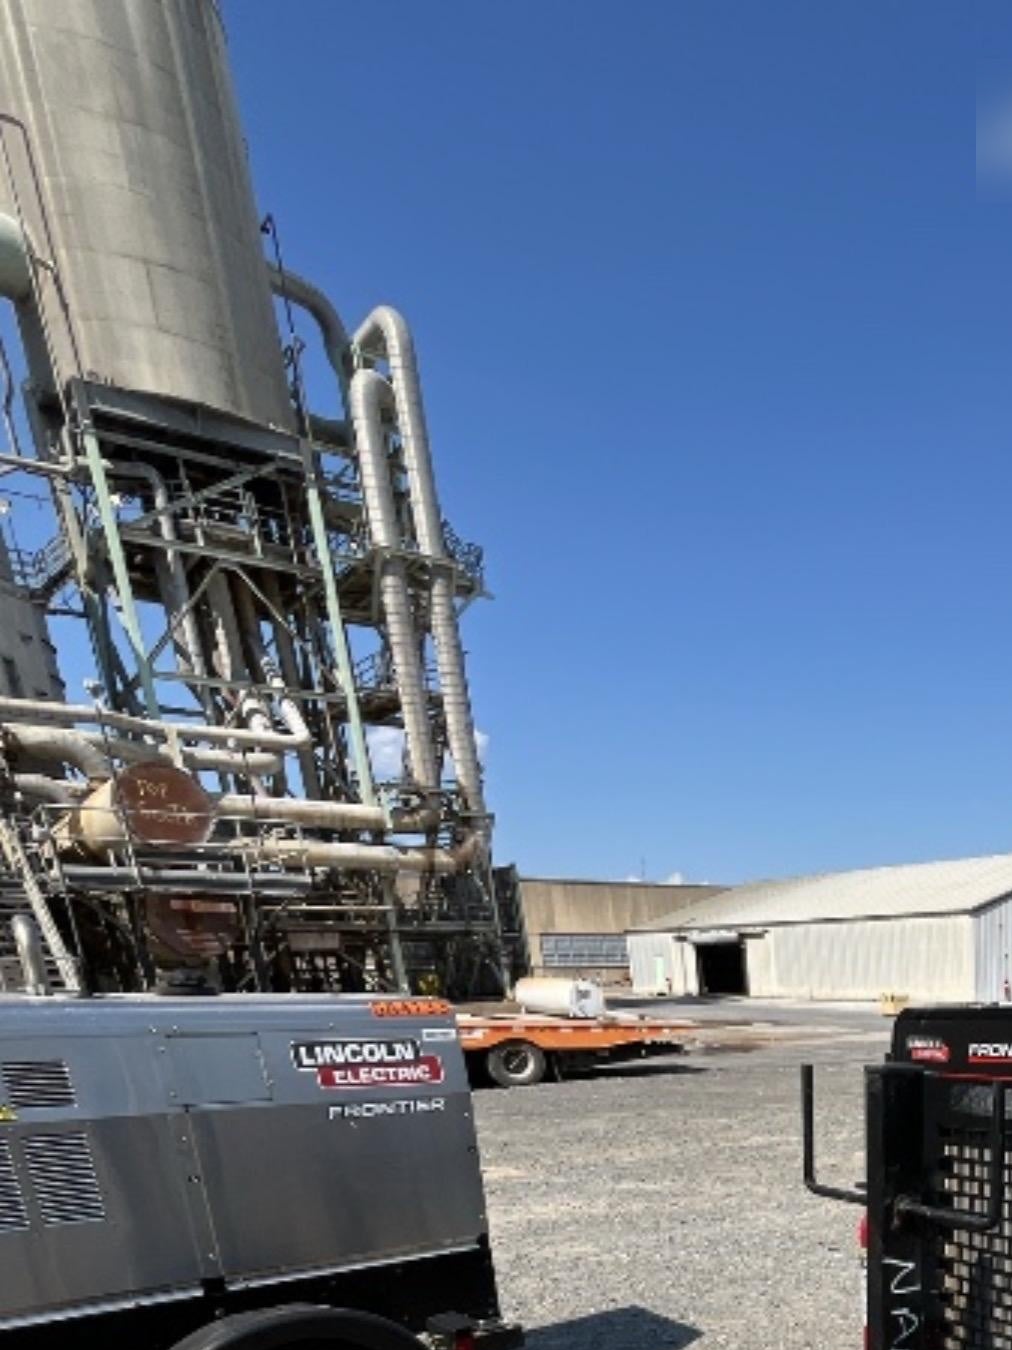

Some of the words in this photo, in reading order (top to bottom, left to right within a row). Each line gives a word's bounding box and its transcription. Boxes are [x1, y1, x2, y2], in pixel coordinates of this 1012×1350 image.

[300, 1043, 414, 1066] LINCOLN
[333, 1065, 431, 1084] ELECTRIC
[329, 1098, 446, 1120] FRONTIER
